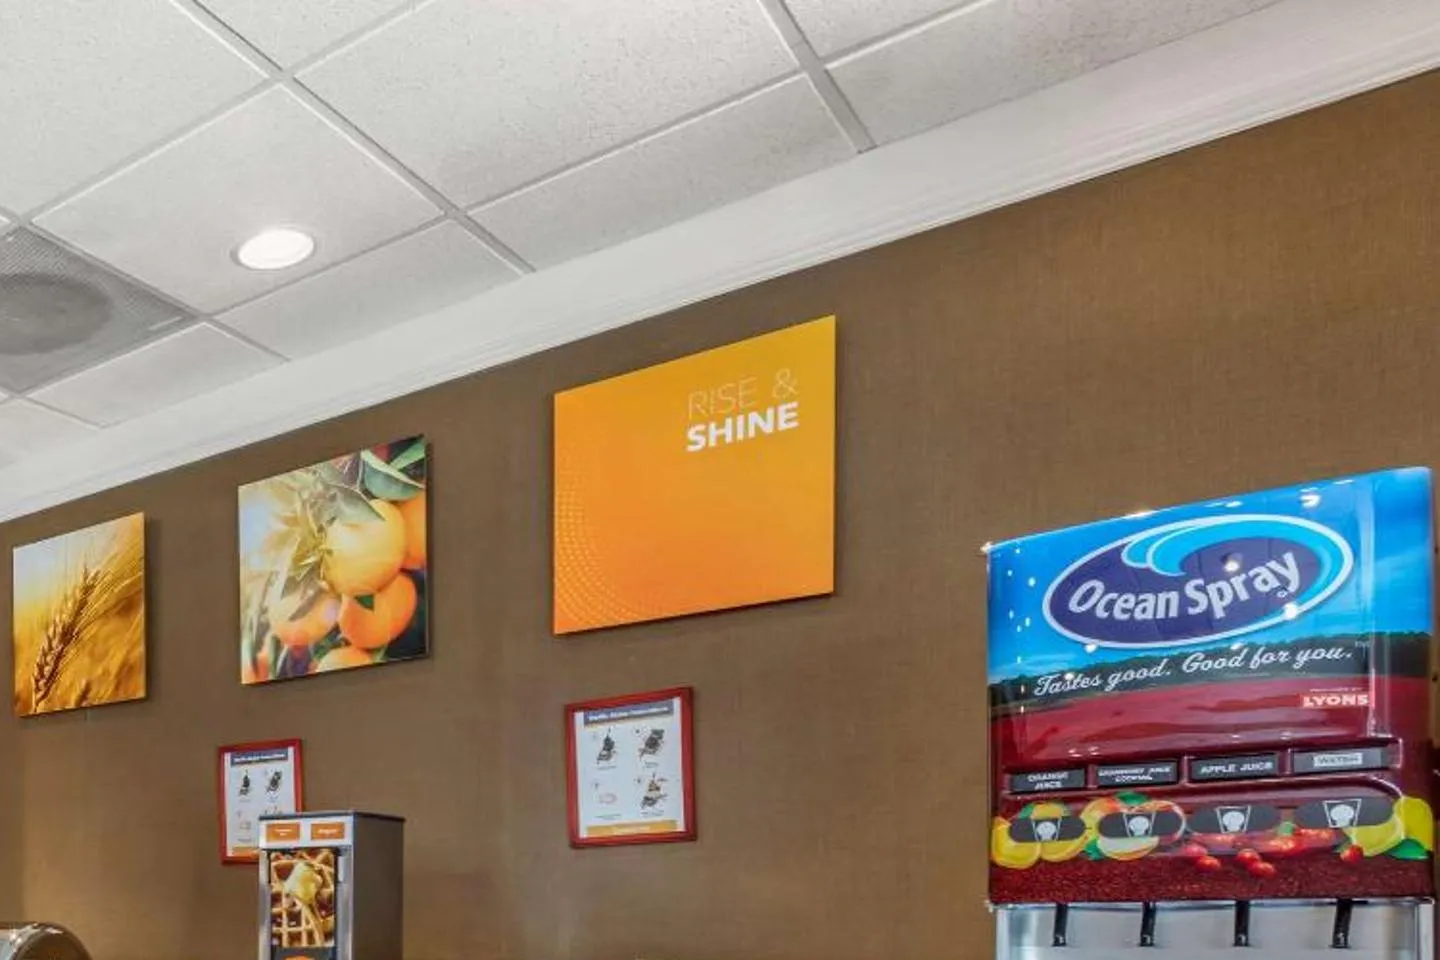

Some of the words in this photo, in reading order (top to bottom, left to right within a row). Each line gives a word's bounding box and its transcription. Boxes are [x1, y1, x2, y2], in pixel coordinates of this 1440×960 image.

[687, 376, 758, 420] RISE
[772, 367, 799, 400] &
[686, 401, 800, 452] SHINE
[1068, 578, 1180, 621] Ocean
[1183, 551, 1301, 619] Spray
[1033, 672, 1102, 696] Tastes
[1104, 658, 1171, 691] good.
[1182, 646, 1246, 674] Good
[1249, 647, 1291, 669] for
[1292, 647, 1353, 669] you.
[1303, 694, 1369, 709] LYONS
[1199, 763, 1236, 774] APPLE
[1240, 761, 1274, 772] JUICE
